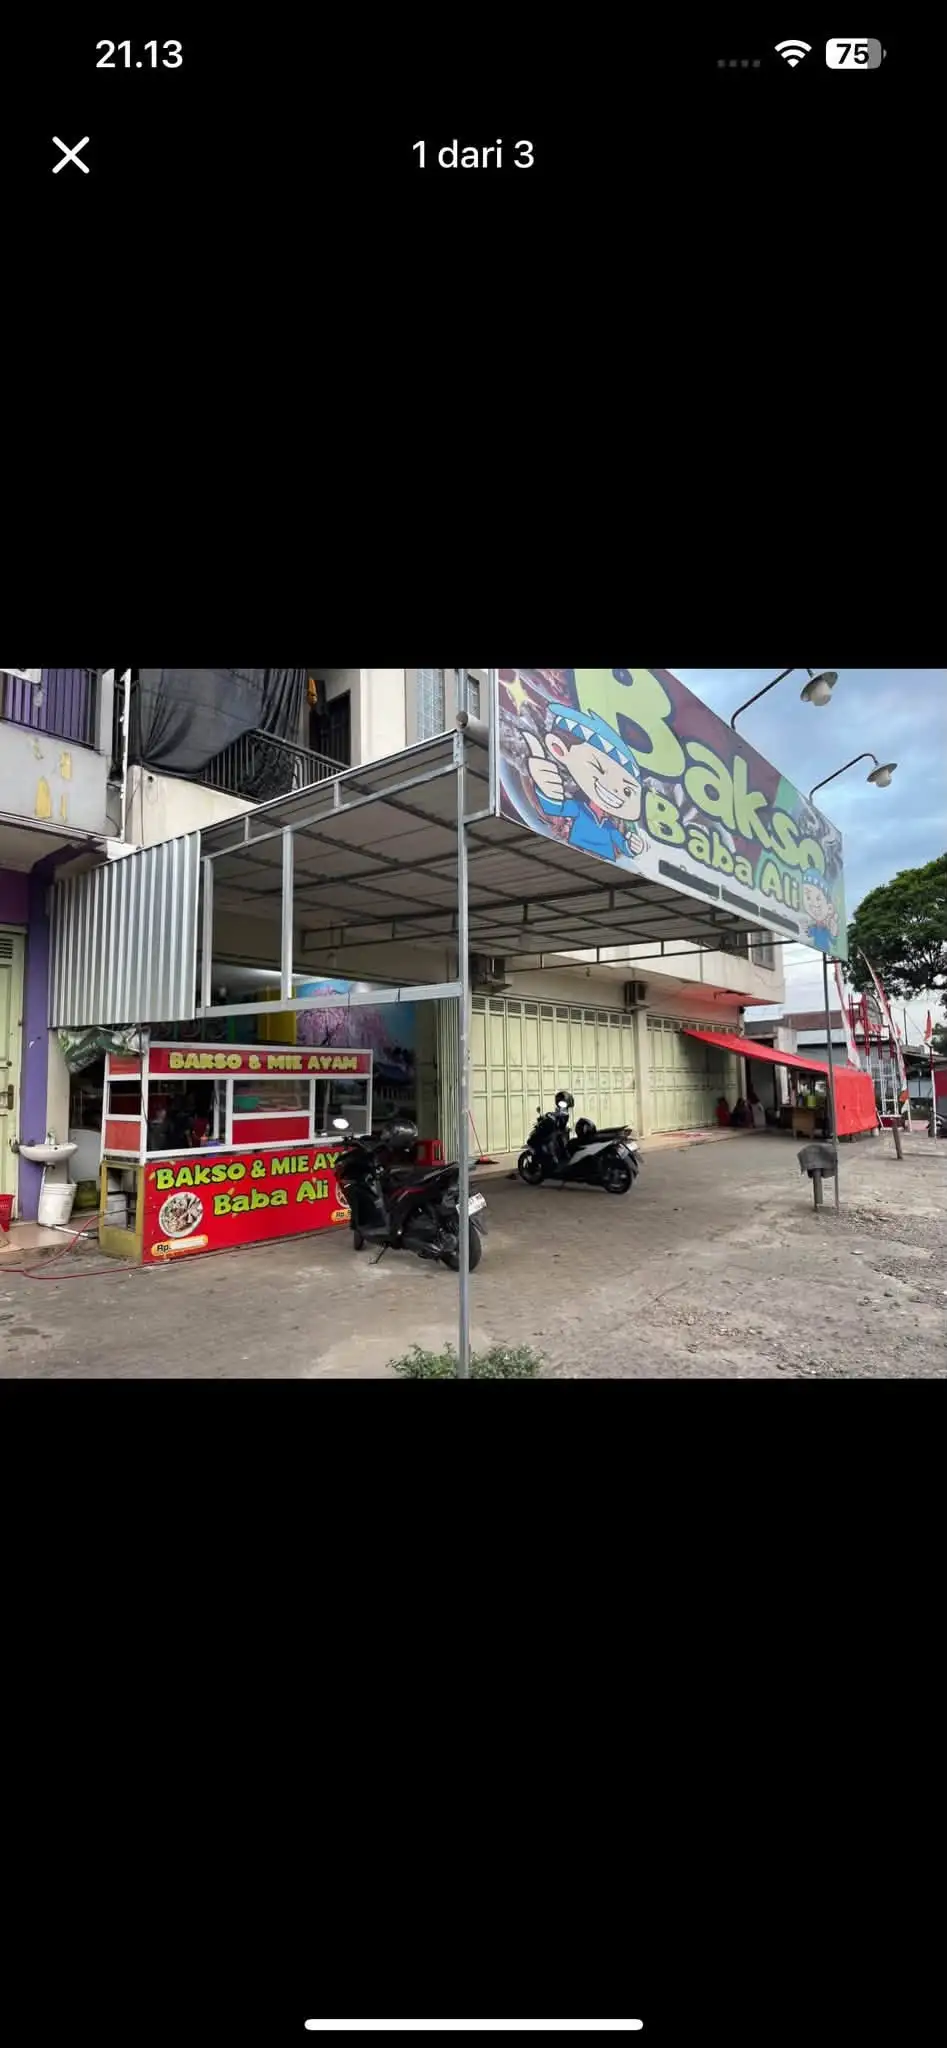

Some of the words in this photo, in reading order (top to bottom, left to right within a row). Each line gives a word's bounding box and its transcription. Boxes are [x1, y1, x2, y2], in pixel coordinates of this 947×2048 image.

[573, 669, 827, 878] Bakso
[644, 790, 755, 889] Baba
[760, 859, 801, 912] Ali
[169, 1051, 243, 1070] BAKSO
[248, 1054, 262, 1070] &
[267, 1055, 302, 1070] MIE
[307, 1055, 358, 1070] AYAM
[250, 1159, 266, 1178] &
[271, 1155, 309, 1175] MIE
[213, 1188, 288, 1216] Baba
[296, 1179, 329, 1202] Ali
